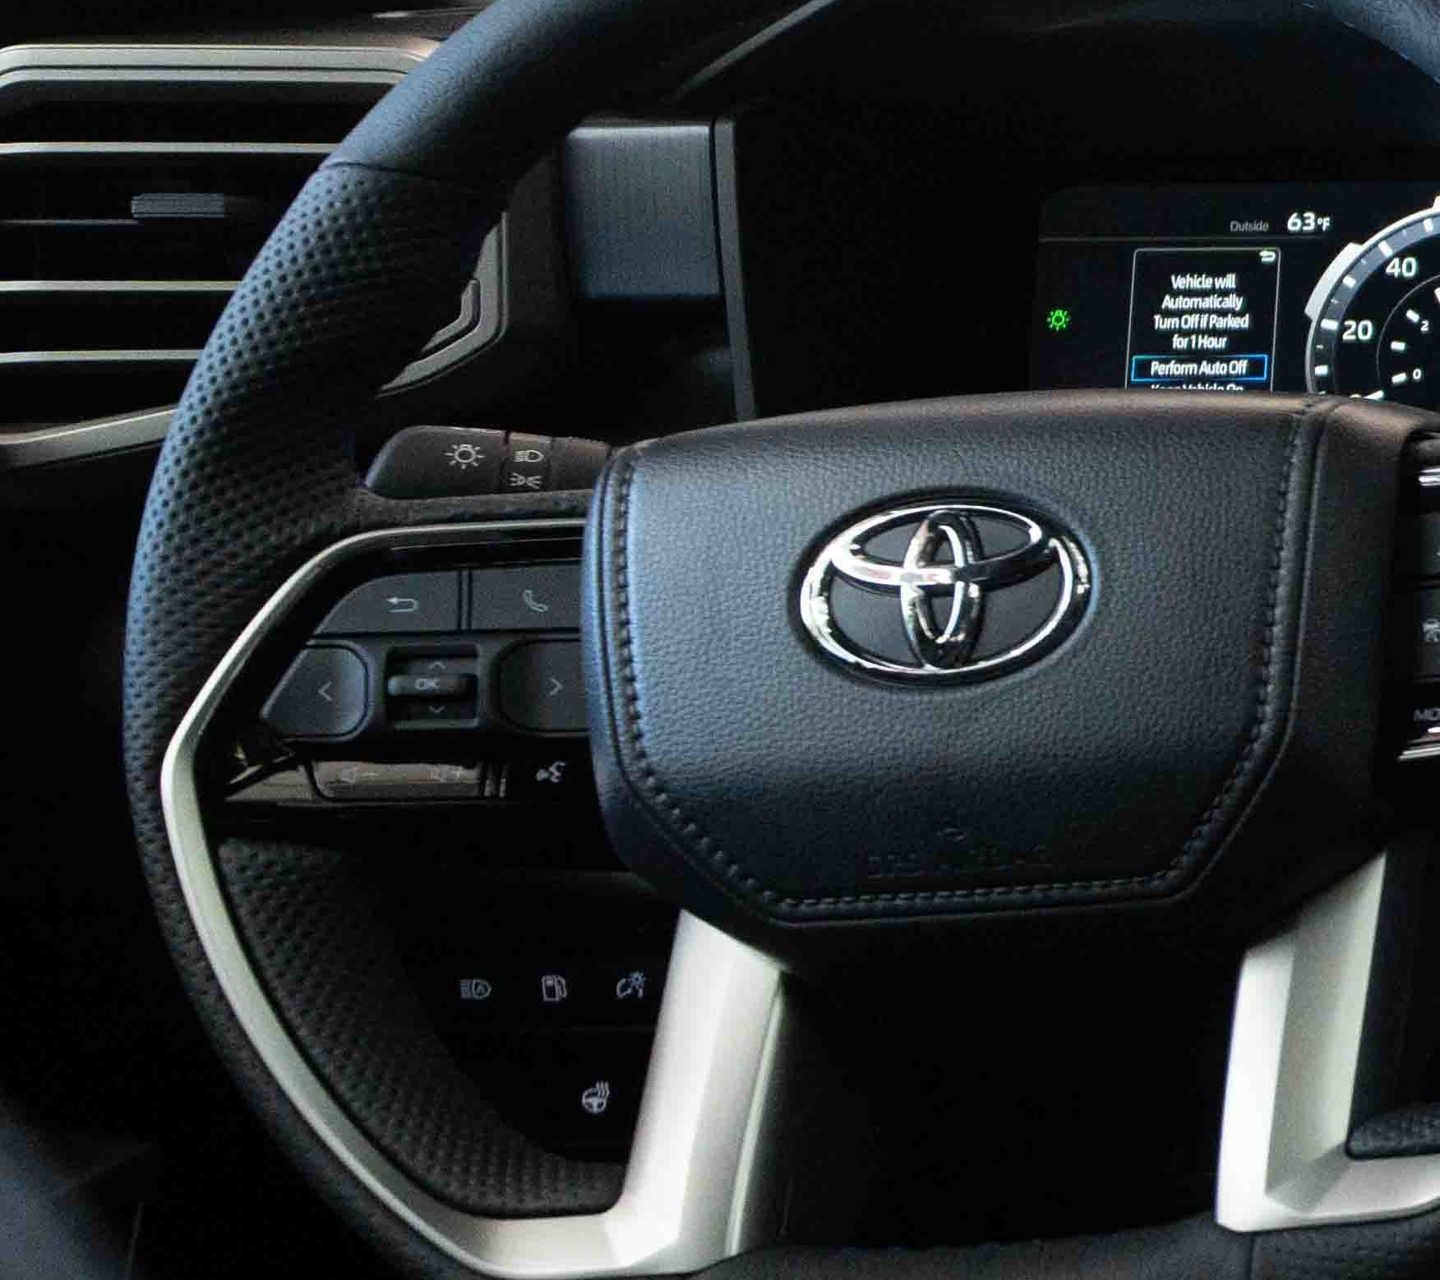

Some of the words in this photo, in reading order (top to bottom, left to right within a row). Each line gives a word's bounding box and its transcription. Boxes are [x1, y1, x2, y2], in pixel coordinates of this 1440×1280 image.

[1229, 220, 1270, 232] Outside
[1385, 257, 1417, 278] 40
[1171, 274, 1213, 289] Vehicle
[1214, 273, 1237, 289] will
[1161, 294, 1244, 311] Automatically
[1153, 314, 1181, 330] Turn
[1181, 313, 1200, 329] Off
[1209, 313, 1250, 329] Parked
[1420, 321, 1429, 332] 2
[1342, 320, 1373, 341] 20
[1171, 334, 1190, 349] for
[1198, 334, 1227, 349] Hour
[1151, 361, 1198, 376] Perform
[1199, 360, 1228, 375] Auto
[1229, 359, 1248, 375] Off
[1412, 369, 1422, 380] 0
